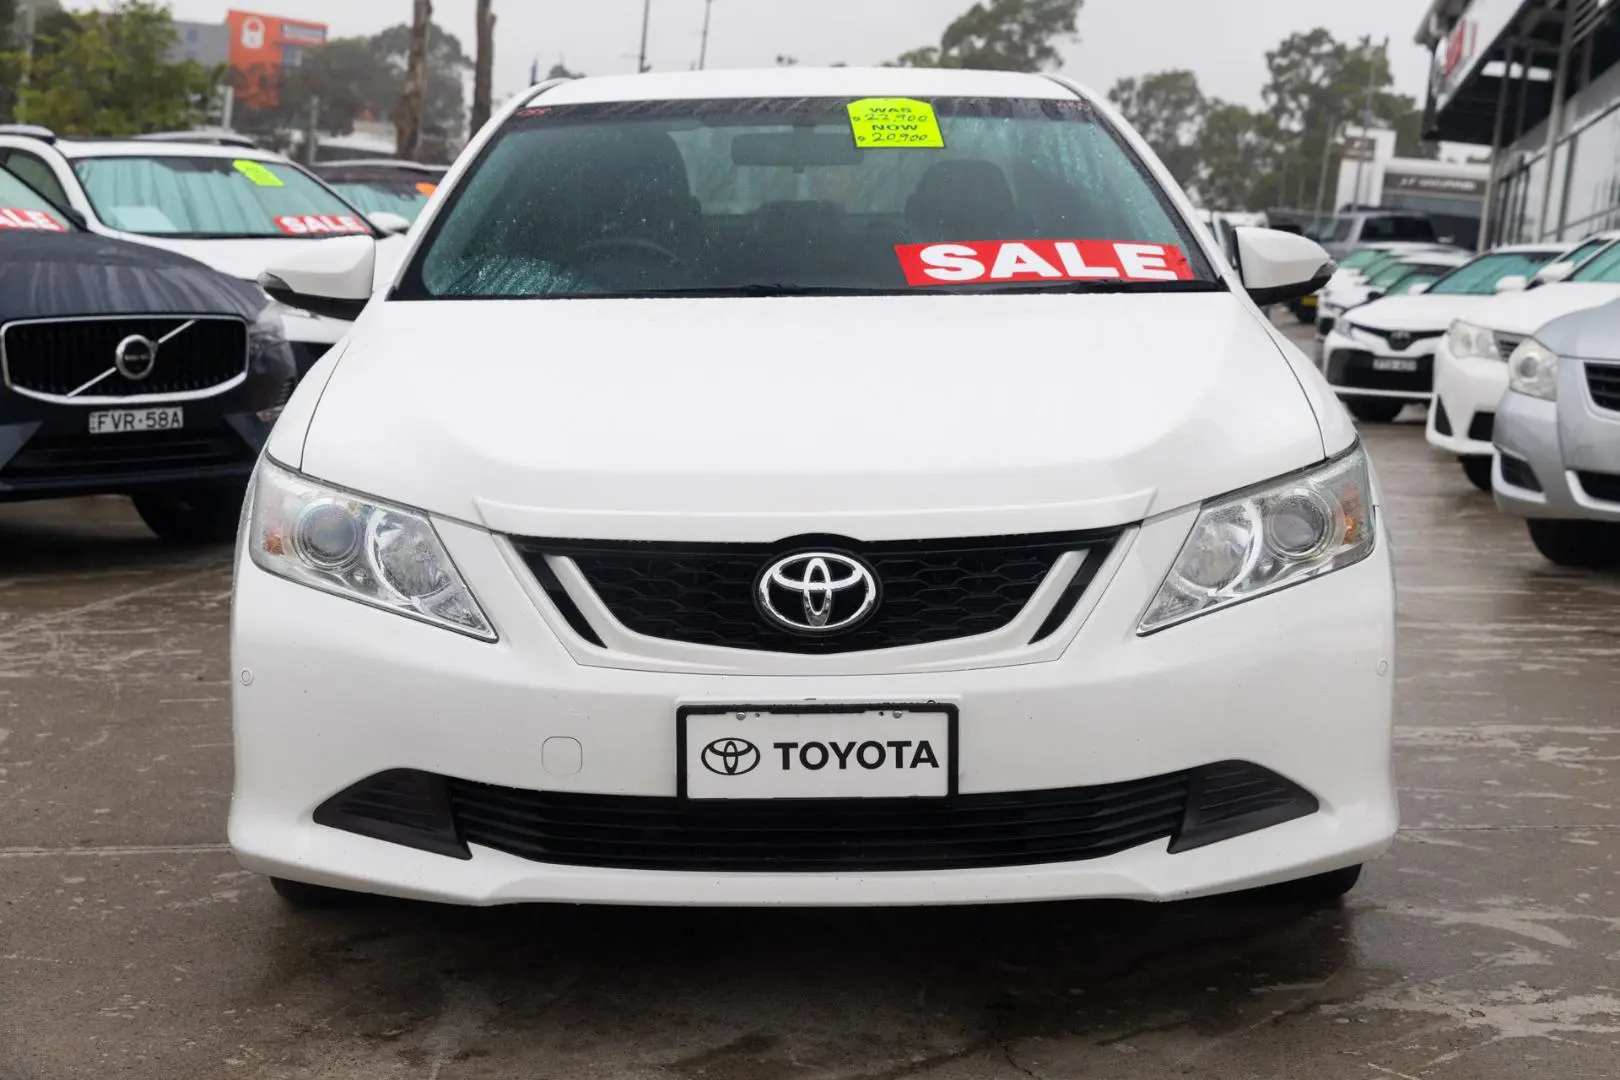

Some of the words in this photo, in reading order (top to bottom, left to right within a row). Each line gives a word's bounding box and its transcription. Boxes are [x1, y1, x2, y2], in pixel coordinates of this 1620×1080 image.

[281, 216, 366, 233] SALE
[919, 242, 1179, 281] SALE
[773, 740, 940, 770] TOYOTA
